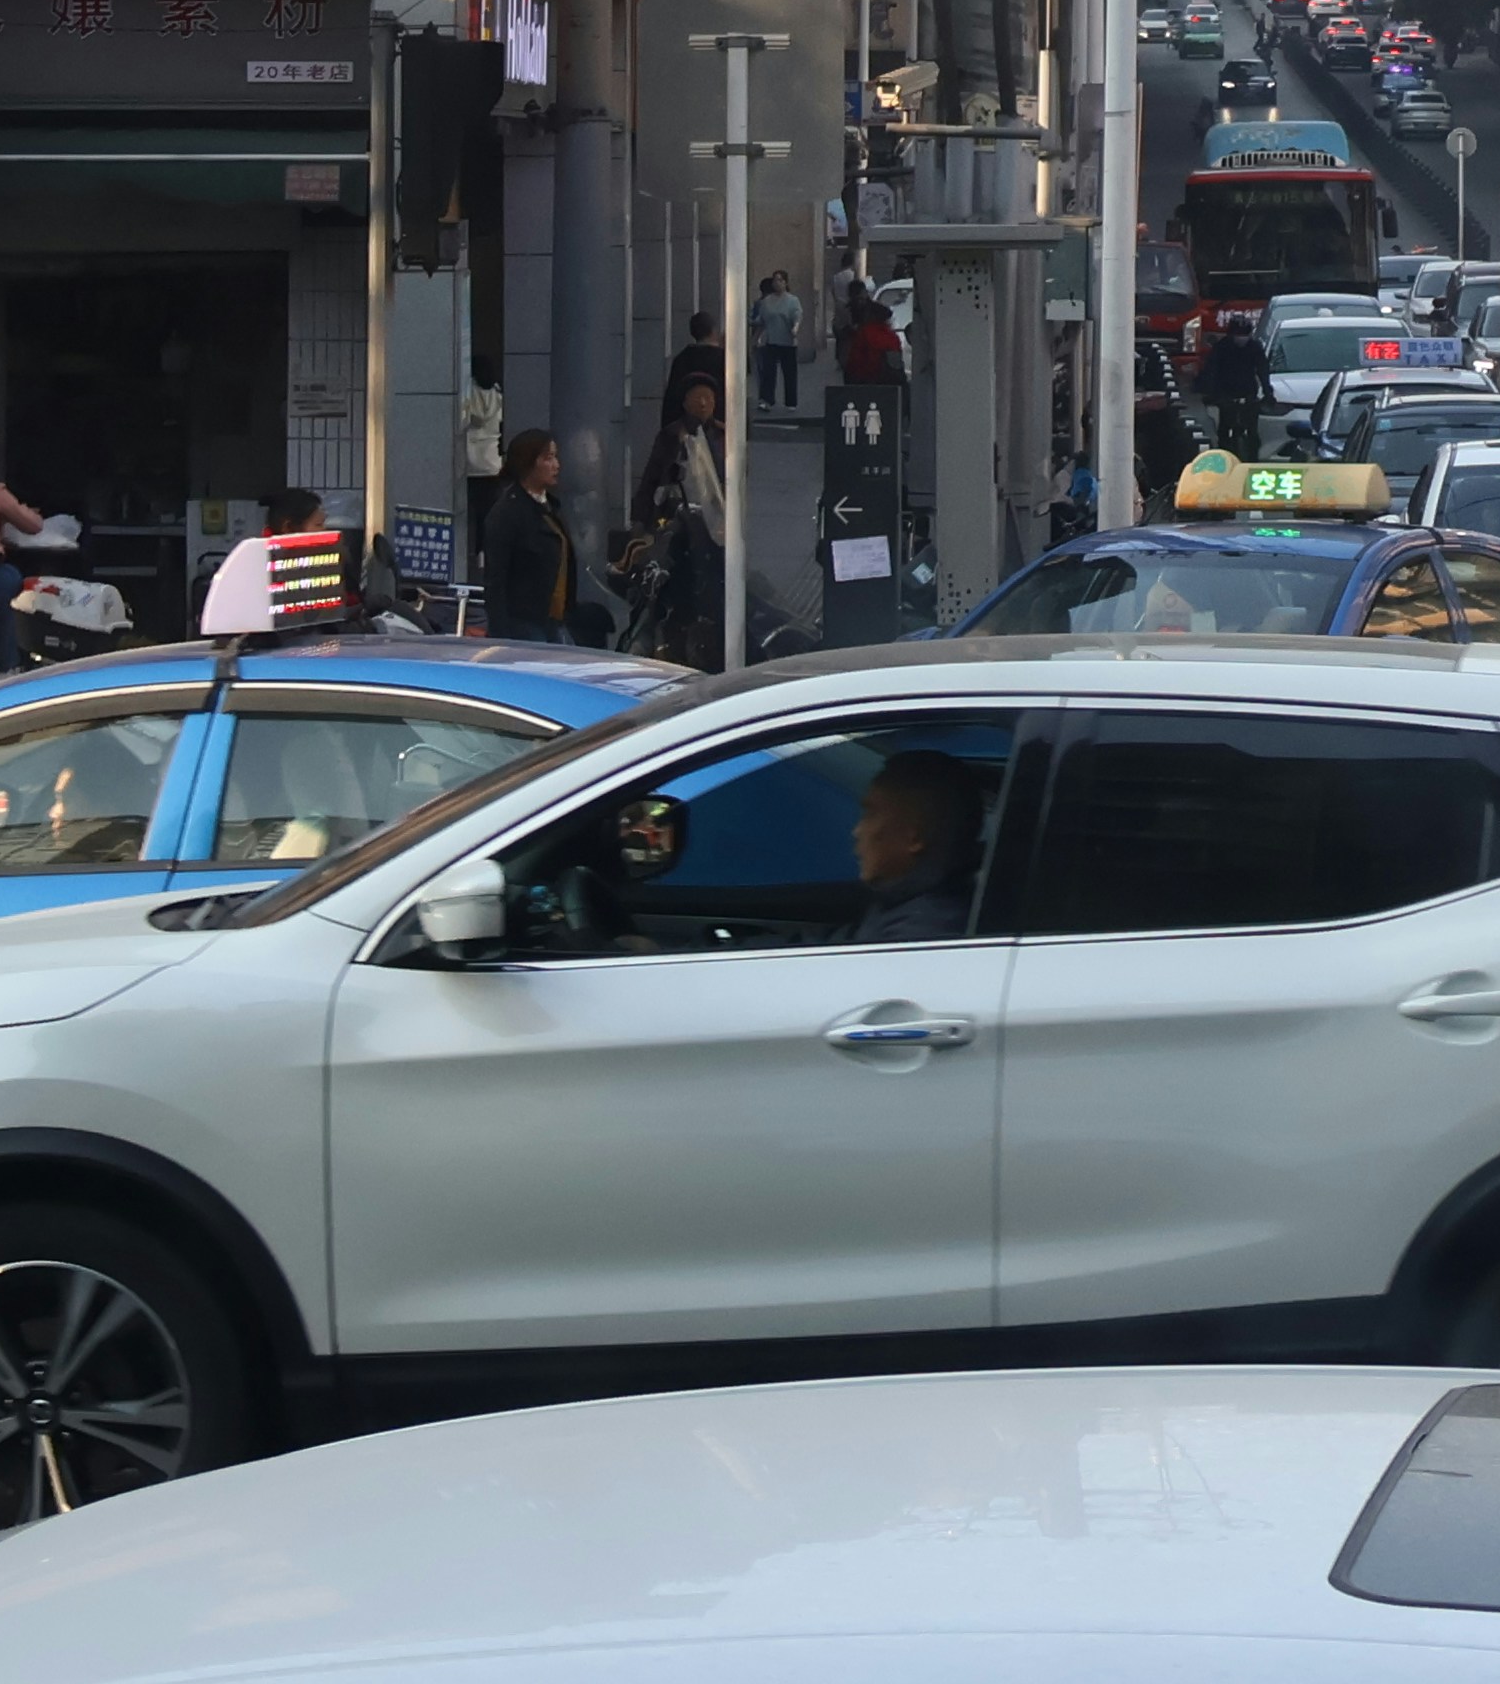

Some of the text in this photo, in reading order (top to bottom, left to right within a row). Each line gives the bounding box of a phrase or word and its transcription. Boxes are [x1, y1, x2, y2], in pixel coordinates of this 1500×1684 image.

[253, 64, 350, 81] 20年老店
[1365, 341, 1400, 360] 有客
[1405, 354, 1458, 365] TAXI
[1250, 471, 1302, 500] 空车
